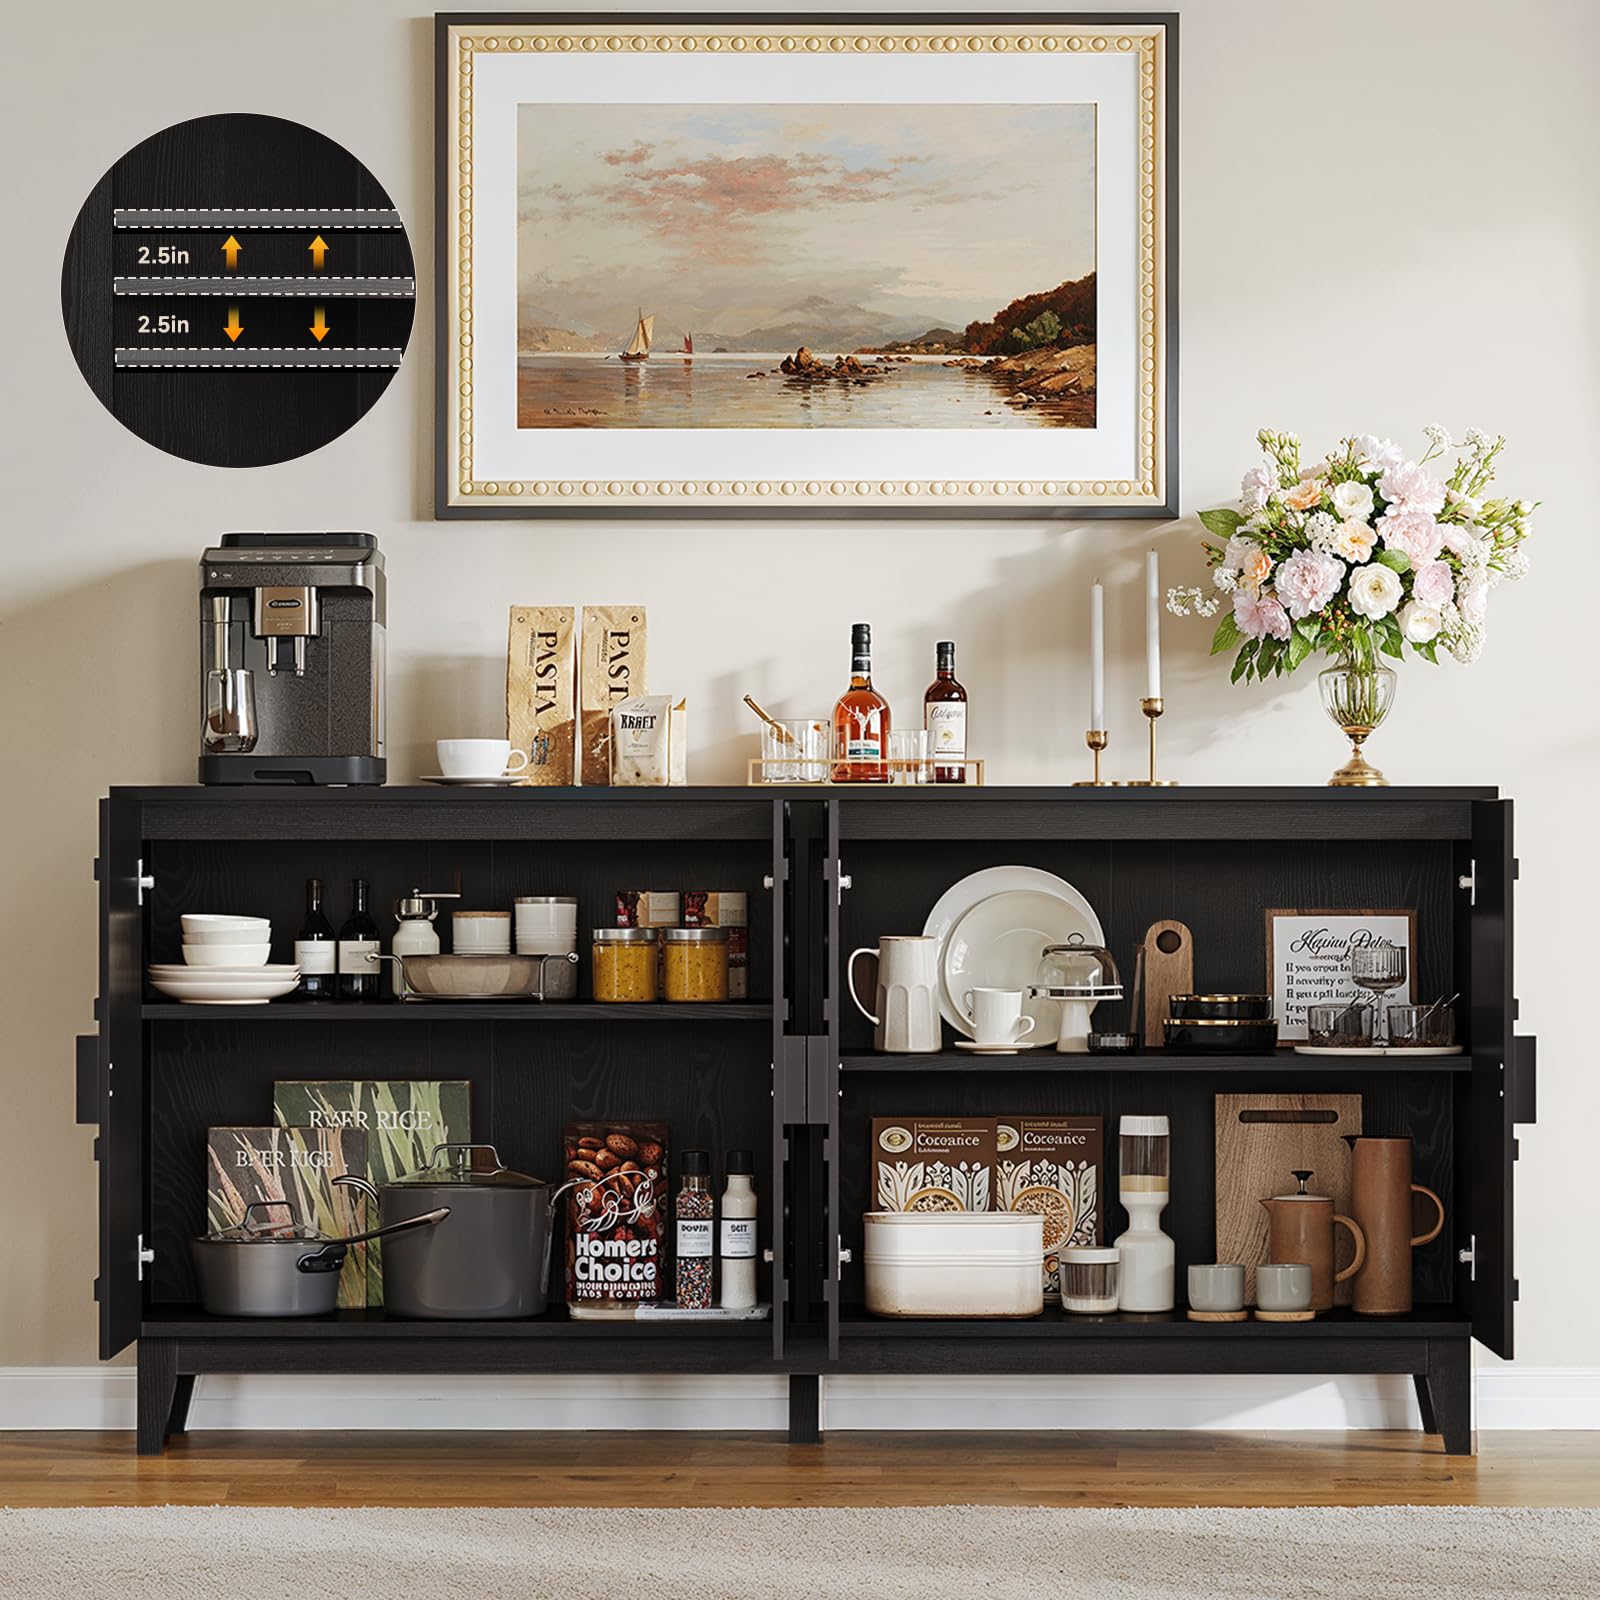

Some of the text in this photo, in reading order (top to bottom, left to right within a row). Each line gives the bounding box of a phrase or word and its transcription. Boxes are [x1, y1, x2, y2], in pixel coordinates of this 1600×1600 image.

[535, 630, 558, 717] PASTA
[576, 1233, 657, 1257] Homers
[574, 1256, 657, 1281] Choice
